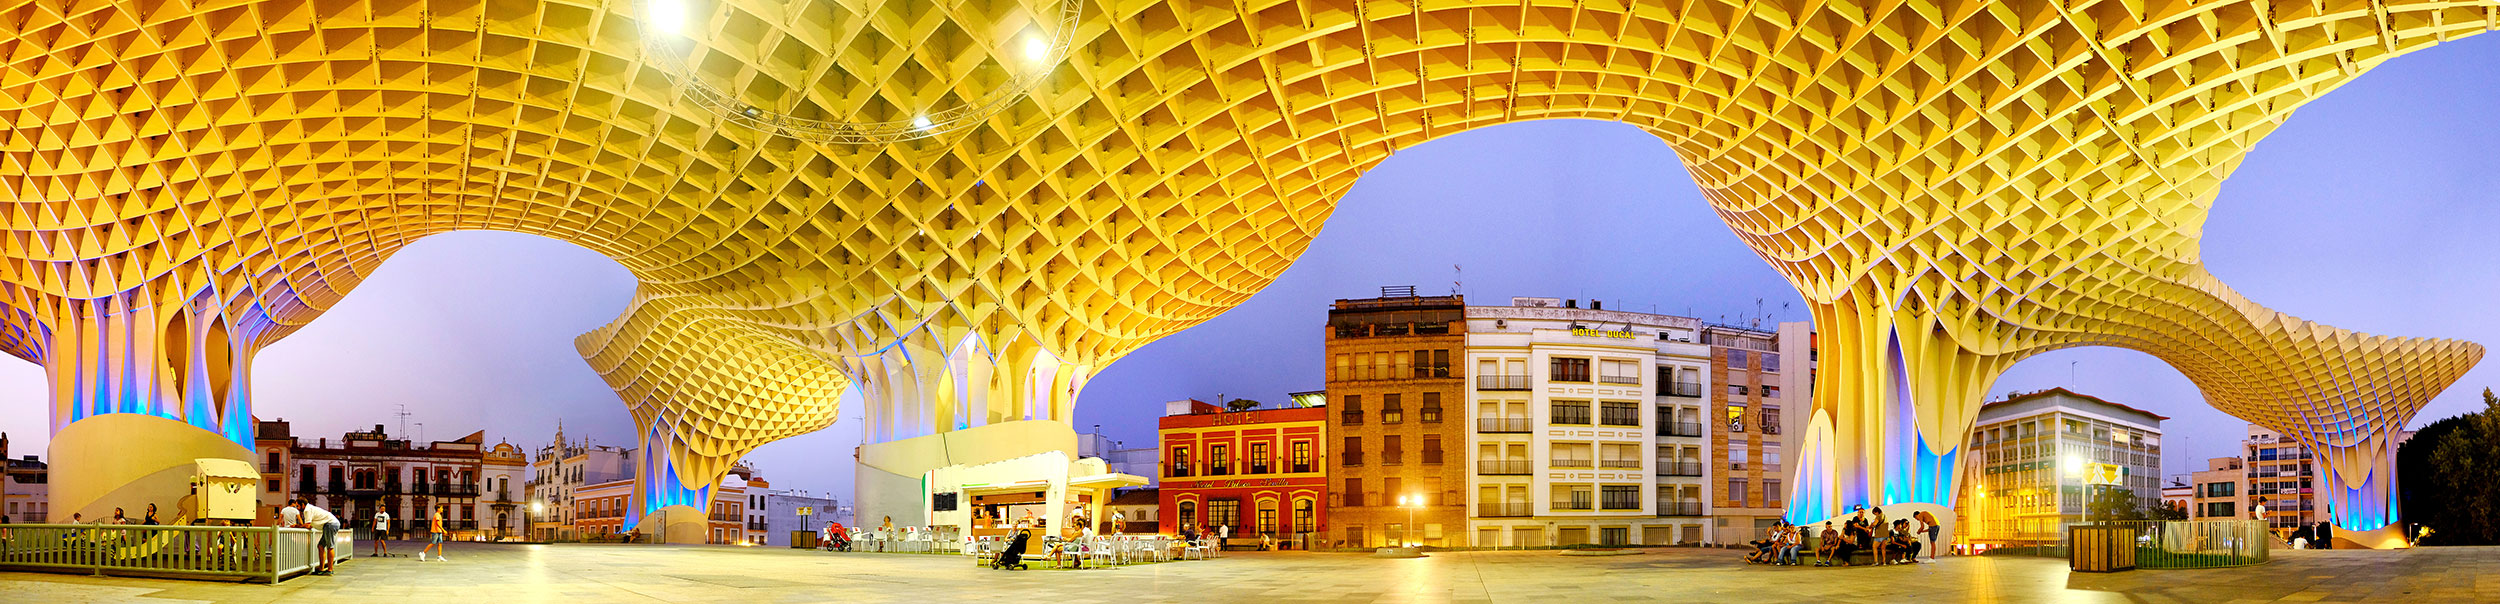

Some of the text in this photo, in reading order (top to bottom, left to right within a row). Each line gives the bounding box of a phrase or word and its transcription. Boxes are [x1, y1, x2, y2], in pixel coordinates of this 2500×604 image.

[1572, 328, 1636, 339] HOTEL DUCAL
[1212, 411, 1265, 425] HOTEL
